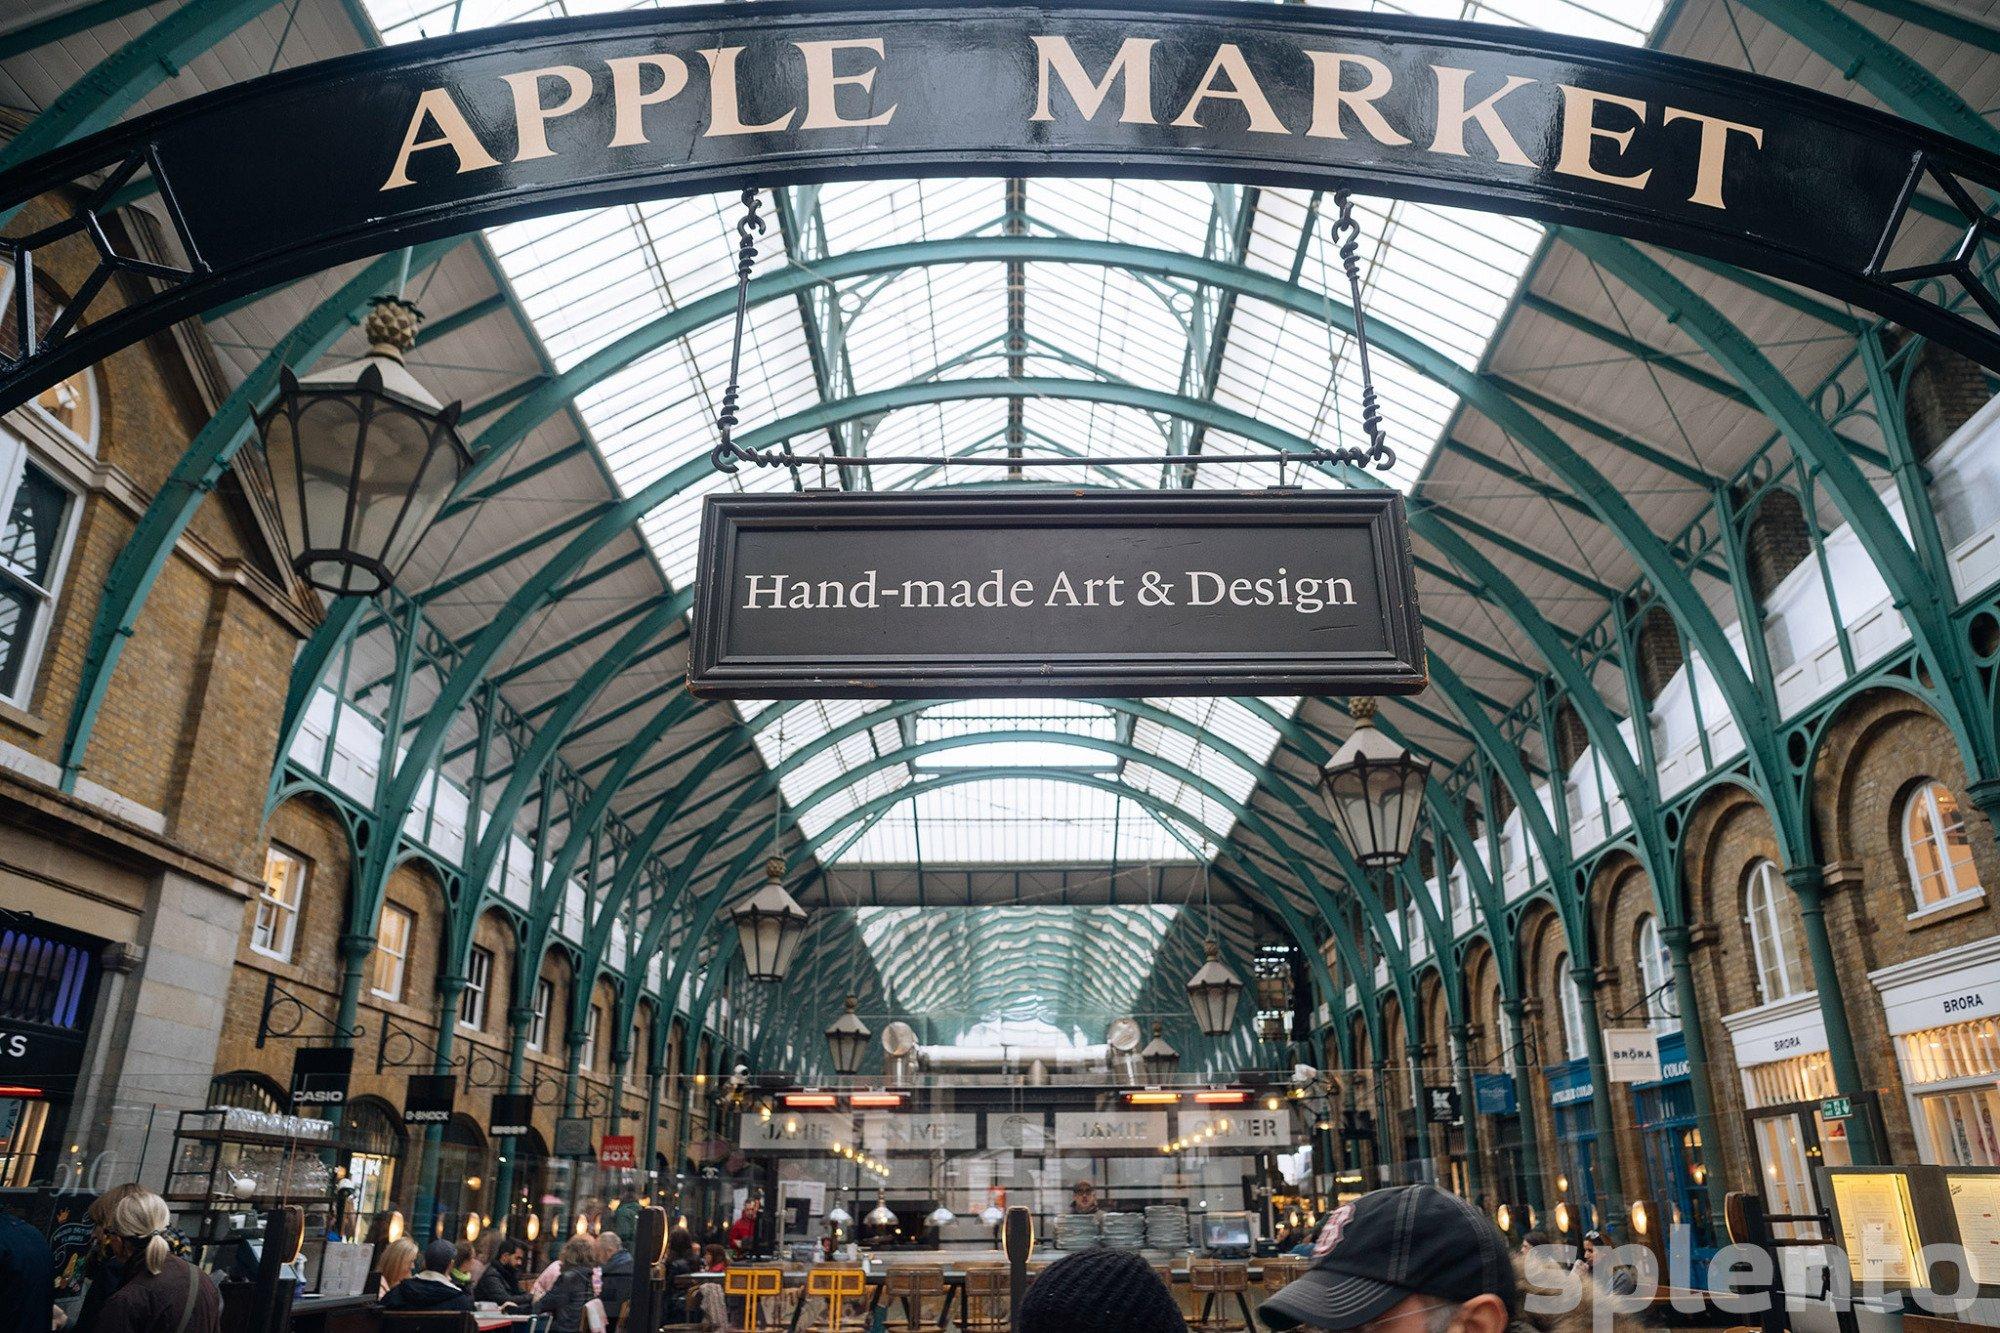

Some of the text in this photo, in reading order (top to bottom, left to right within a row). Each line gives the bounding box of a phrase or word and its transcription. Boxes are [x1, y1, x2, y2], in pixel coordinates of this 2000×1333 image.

[379, 35, 1764, 209] APPLE MARKET
[742, 569, 1357, 614] Hand-made Art & Design
[1943, 993, 1984, 1014] BRORA
[0, 1032, 28, 1057] S
[1774, 1036, 1801, 1052] BRORA
[293, 1090, 344, 1103] CASIO
[1078, 1120, 1149, 1139] JAMIE
[602, 1150, 631, 1162] BOX
